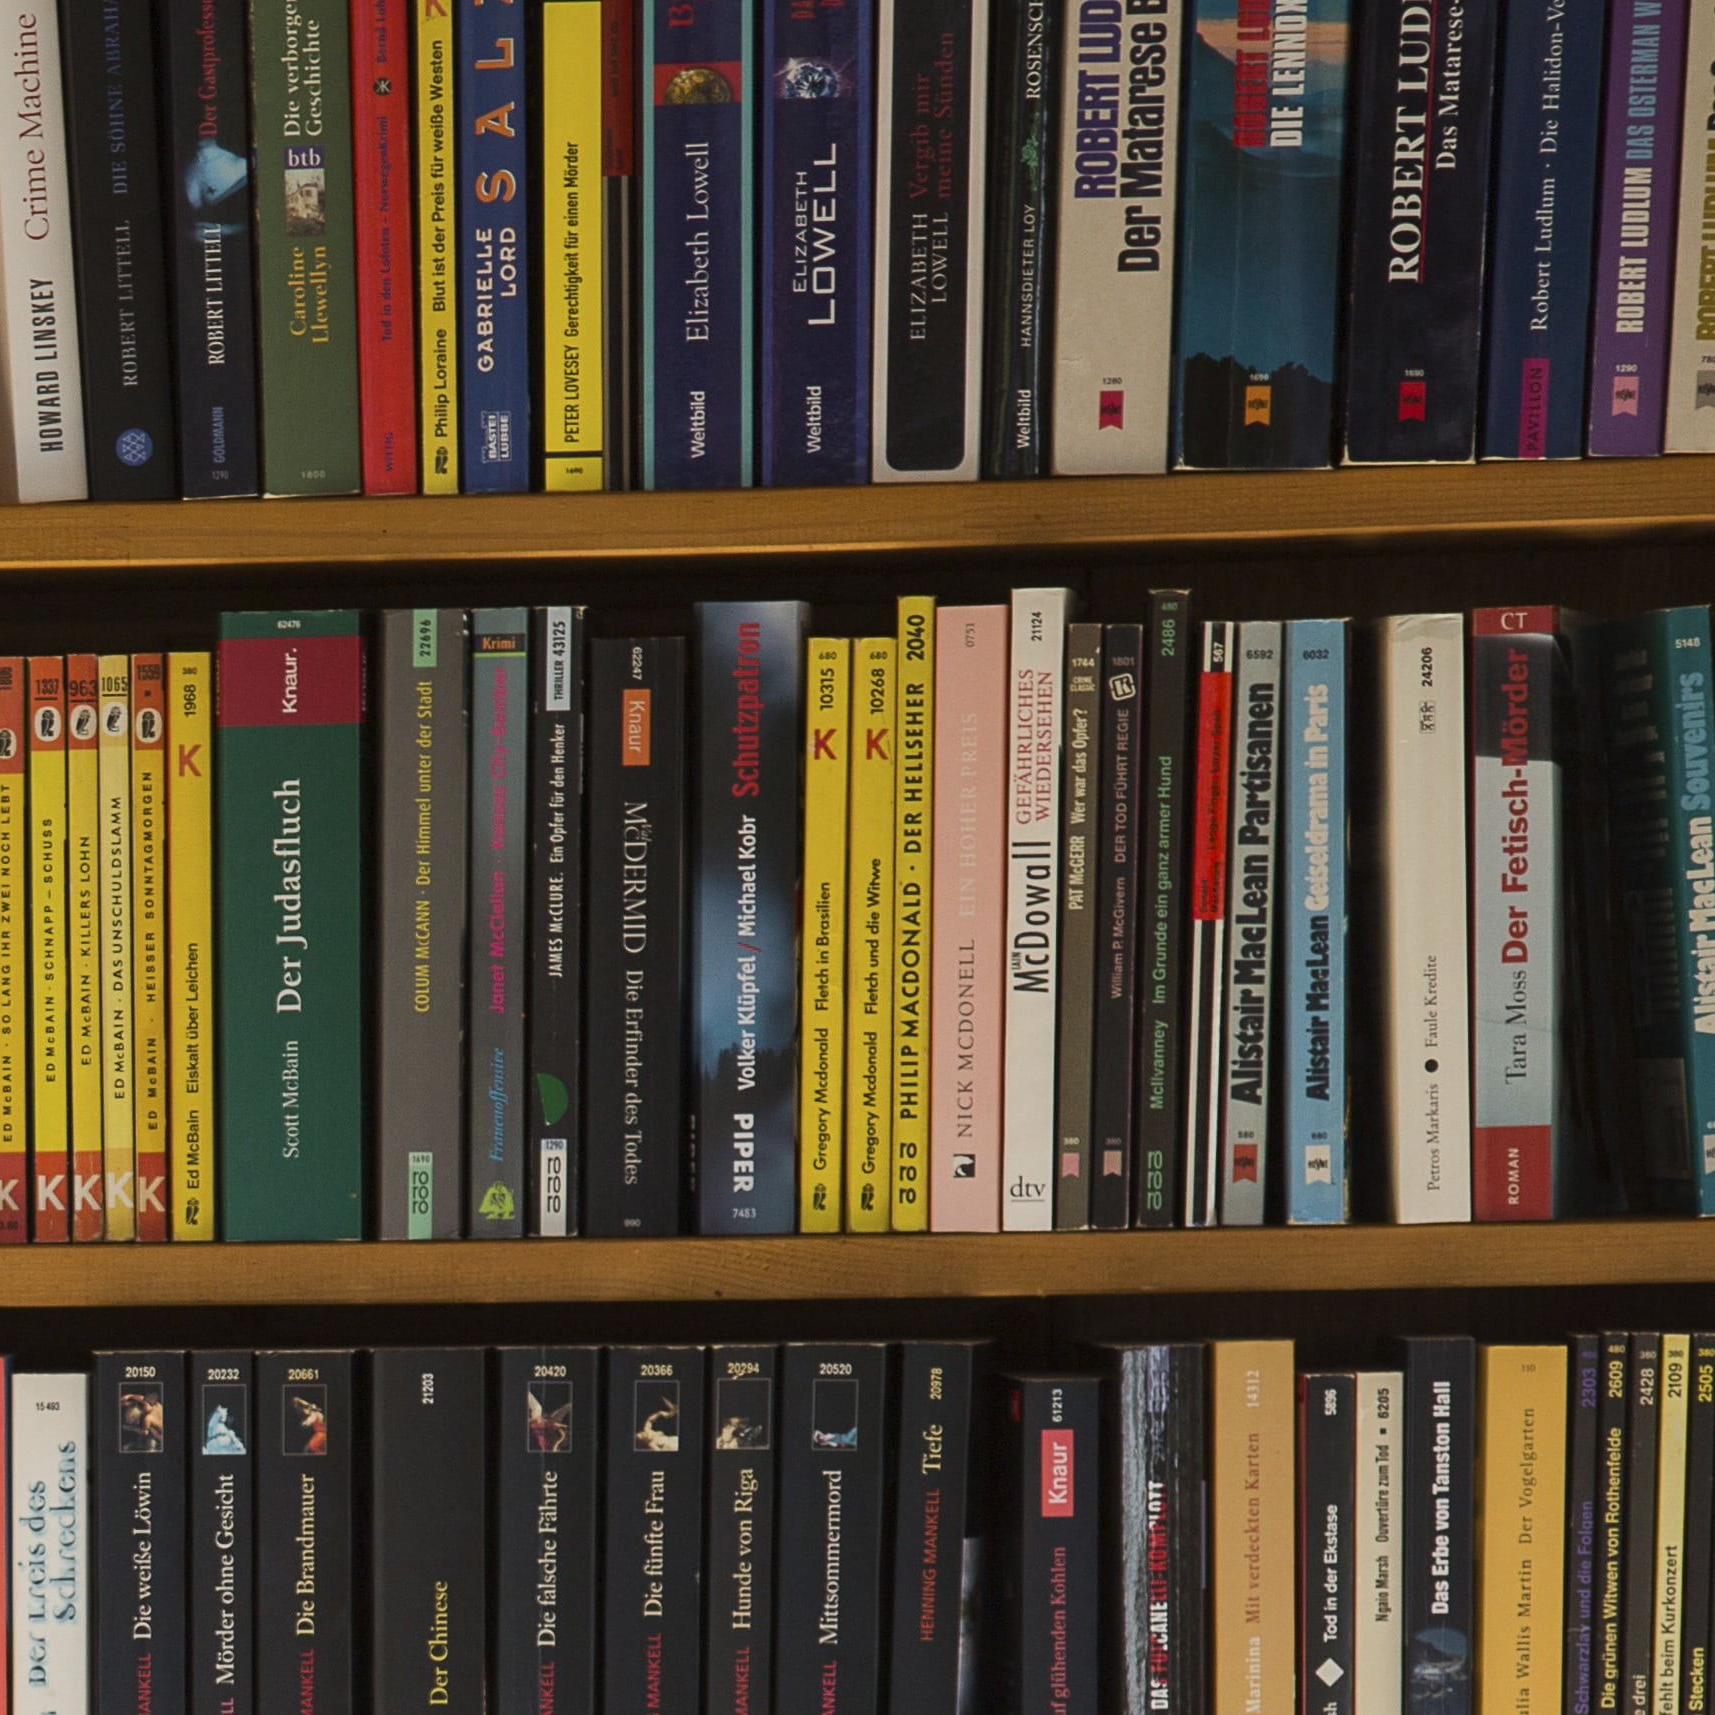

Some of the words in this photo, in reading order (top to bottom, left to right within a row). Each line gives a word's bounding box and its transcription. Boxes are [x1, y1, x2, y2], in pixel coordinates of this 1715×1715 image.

[17, 12, 41, 139] Machine
[1123, 21, 1166, 197] Matarese
[23, 149, 50, 241] Crime
[287, 148, 321, 167] btb
[686, 143, 709, 221] Lowell
[501, 226, 516, 297] LORD
[1120, 206, 1160, 271] Der
[31, 277, 56, 358] LINSKEY
[477, 226, 494, 374] GABRIELLE
[684, 232, 710, 343] Elizabeth
[38, 366, 62, 453] HOWARD
[481, 636, 516, 651] Krimi
[1501, 612, 1528, 629] CT
[281, 648, 298, 714] Knaur.
[733, 622, 761, 797] Schutzpatron
[1501, 647, 1528, 893] Fetisch-Mörder
[274, 778, 308, 949] Judasfluch
[1502, 906, 1528, 964] Der
[276, 957, 304, 1012] Der
[733, 1114, 754, 1193] PIPER
[1010, 1178, 1046, 1198] dtv
[1508, 1148, 1520, 1204] ROMAN
[125, 1366, 157, 1378] 20150
[1048, 1442, 1068, 1506] Knaur
[819, 1469, 844, 1645] Mittsommermord
